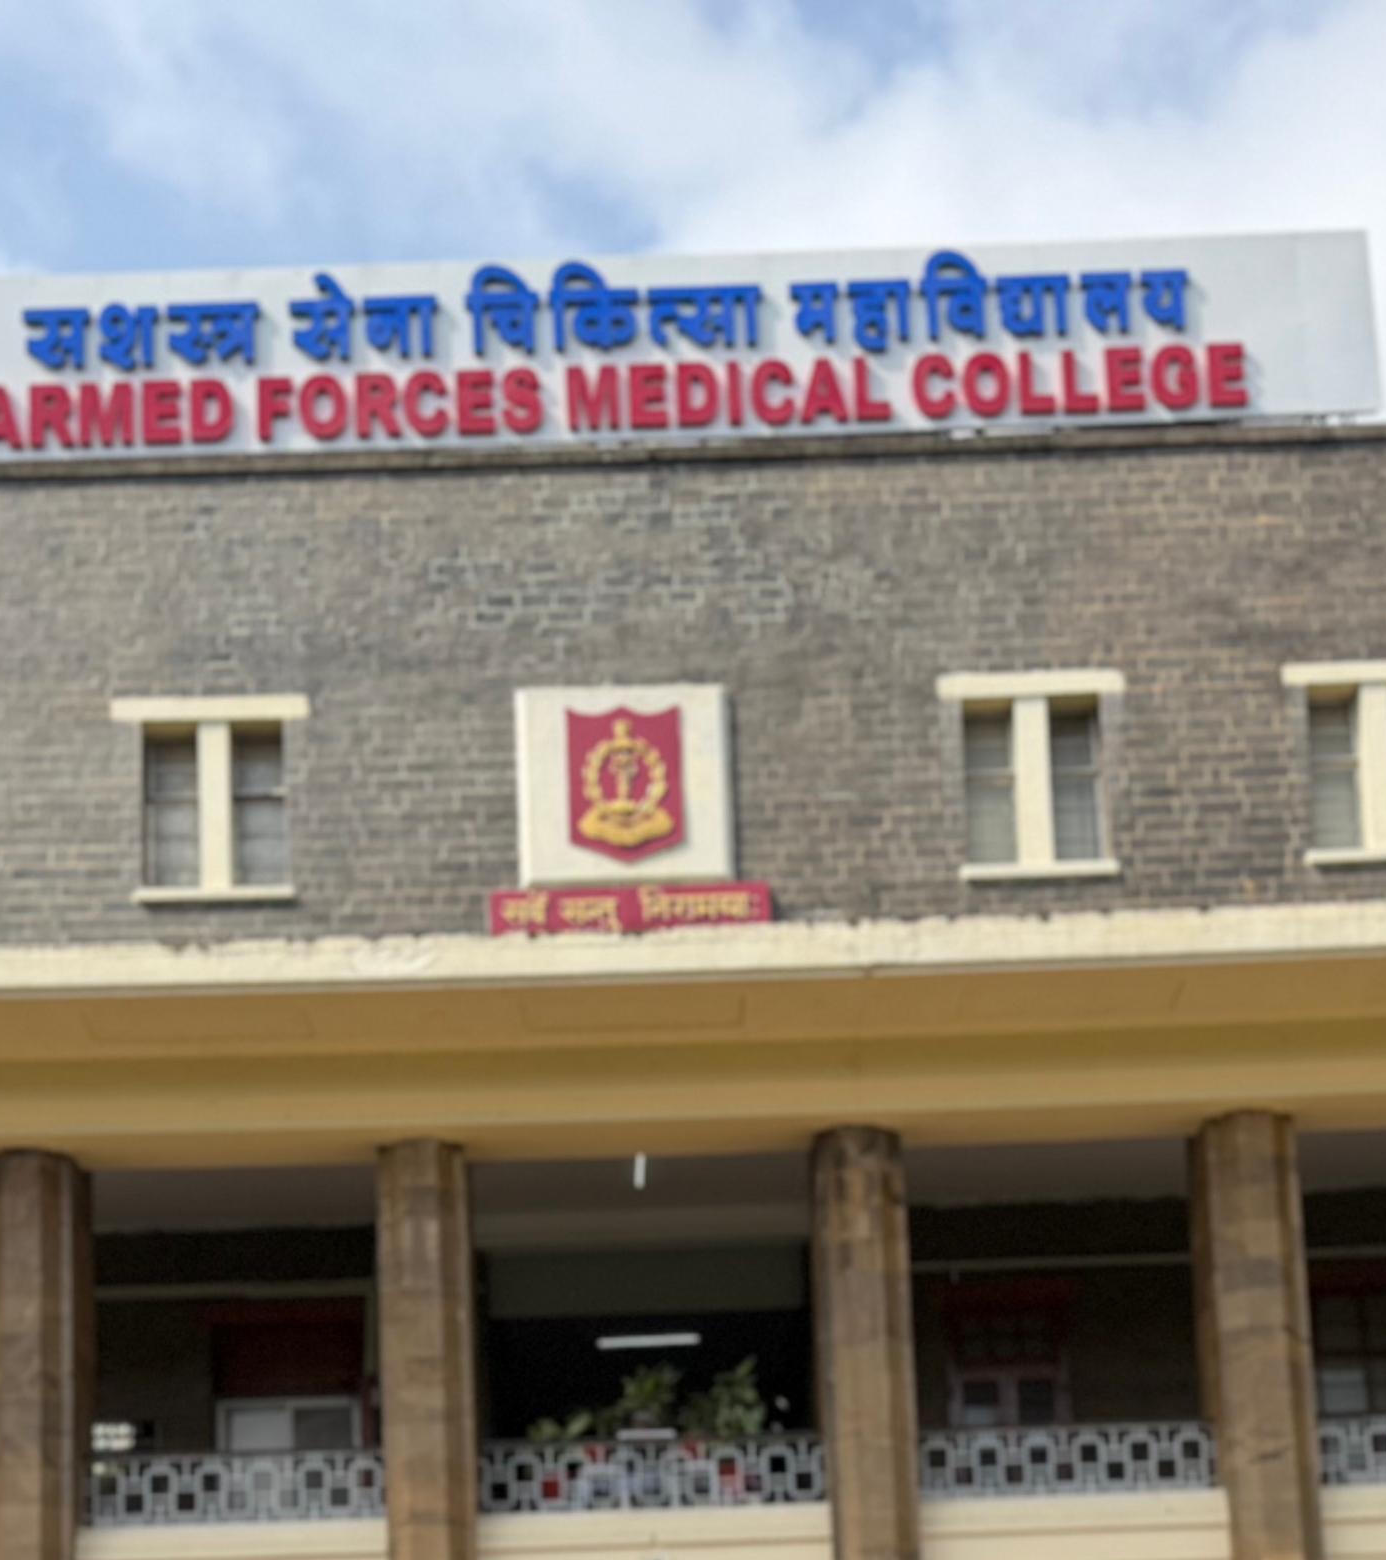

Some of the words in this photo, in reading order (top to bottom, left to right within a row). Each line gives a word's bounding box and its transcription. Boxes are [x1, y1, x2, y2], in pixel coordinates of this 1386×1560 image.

[22, 300, 262, 371] सशस्त्र
[288, 273, 439, 360] सेना
[464, 261, 764, 356] चिकित्सा
[788, 249, 1190, 353] महाविद्यालय
[256, 366, 545, 441] FORCES
[564, 357, 894, 431] MEDICAL
[911, 342, 1250, 420] COLLEGE
